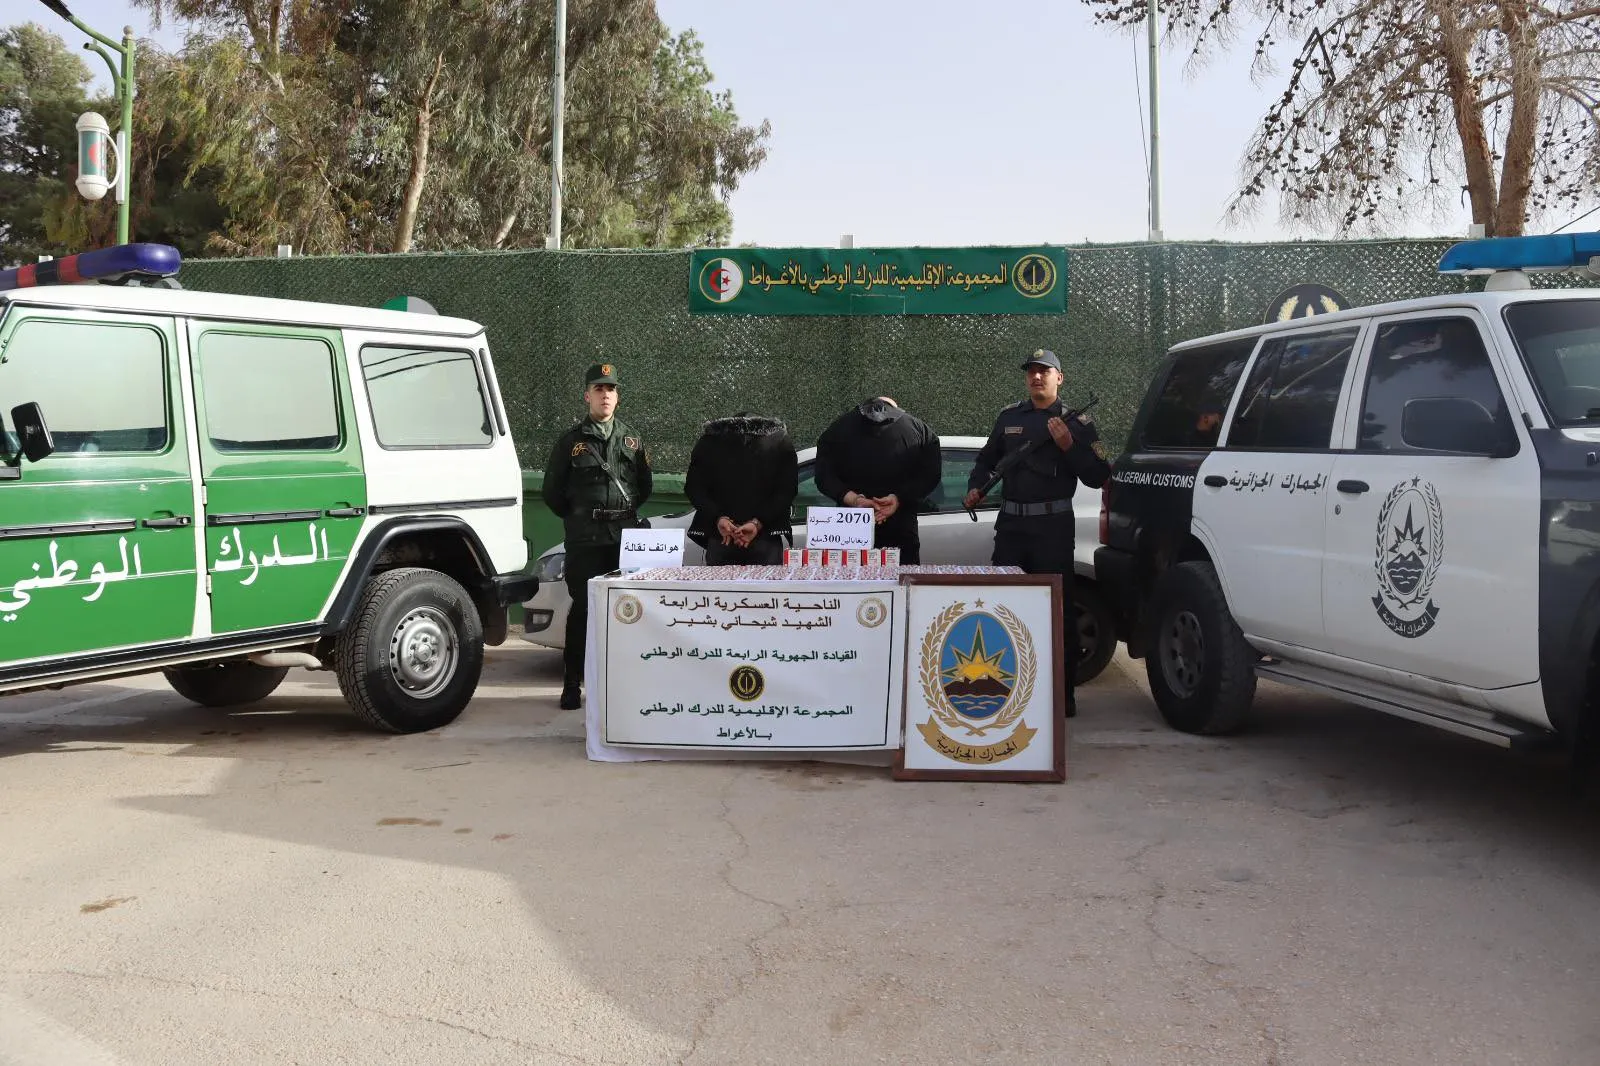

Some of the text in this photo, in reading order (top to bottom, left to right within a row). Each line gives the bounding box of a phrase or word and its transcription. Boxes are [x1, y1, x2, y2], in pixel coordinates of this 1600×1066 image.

[749, 260, 1007, 293] المجموعة الإقليمية للدرك الوطني بالأغواط
[1113, 471, 1194, 489] ALGERIAN CUSTOMS
[1229, 470, 1327, 494] الجمارك الجزائرية
[836, 512, 870, 524] 2070
[625, 541, 679, 554] هواتف نقالة
[0, 522, 329, 622] الدرك الوطني
[659, 595, 841, 613] الناحية العسكرية الرابعة
[667, 614, 832, 631] الشهيد شيحاني بشير
[640, 646, 857, 662] القيادة الجهوية الرابعة للدرك الوطني
[640, 702, 853, 719] المجموعة الإقليمية للدرك الوطني
[717, 726, 773, 740] بالأغواط
